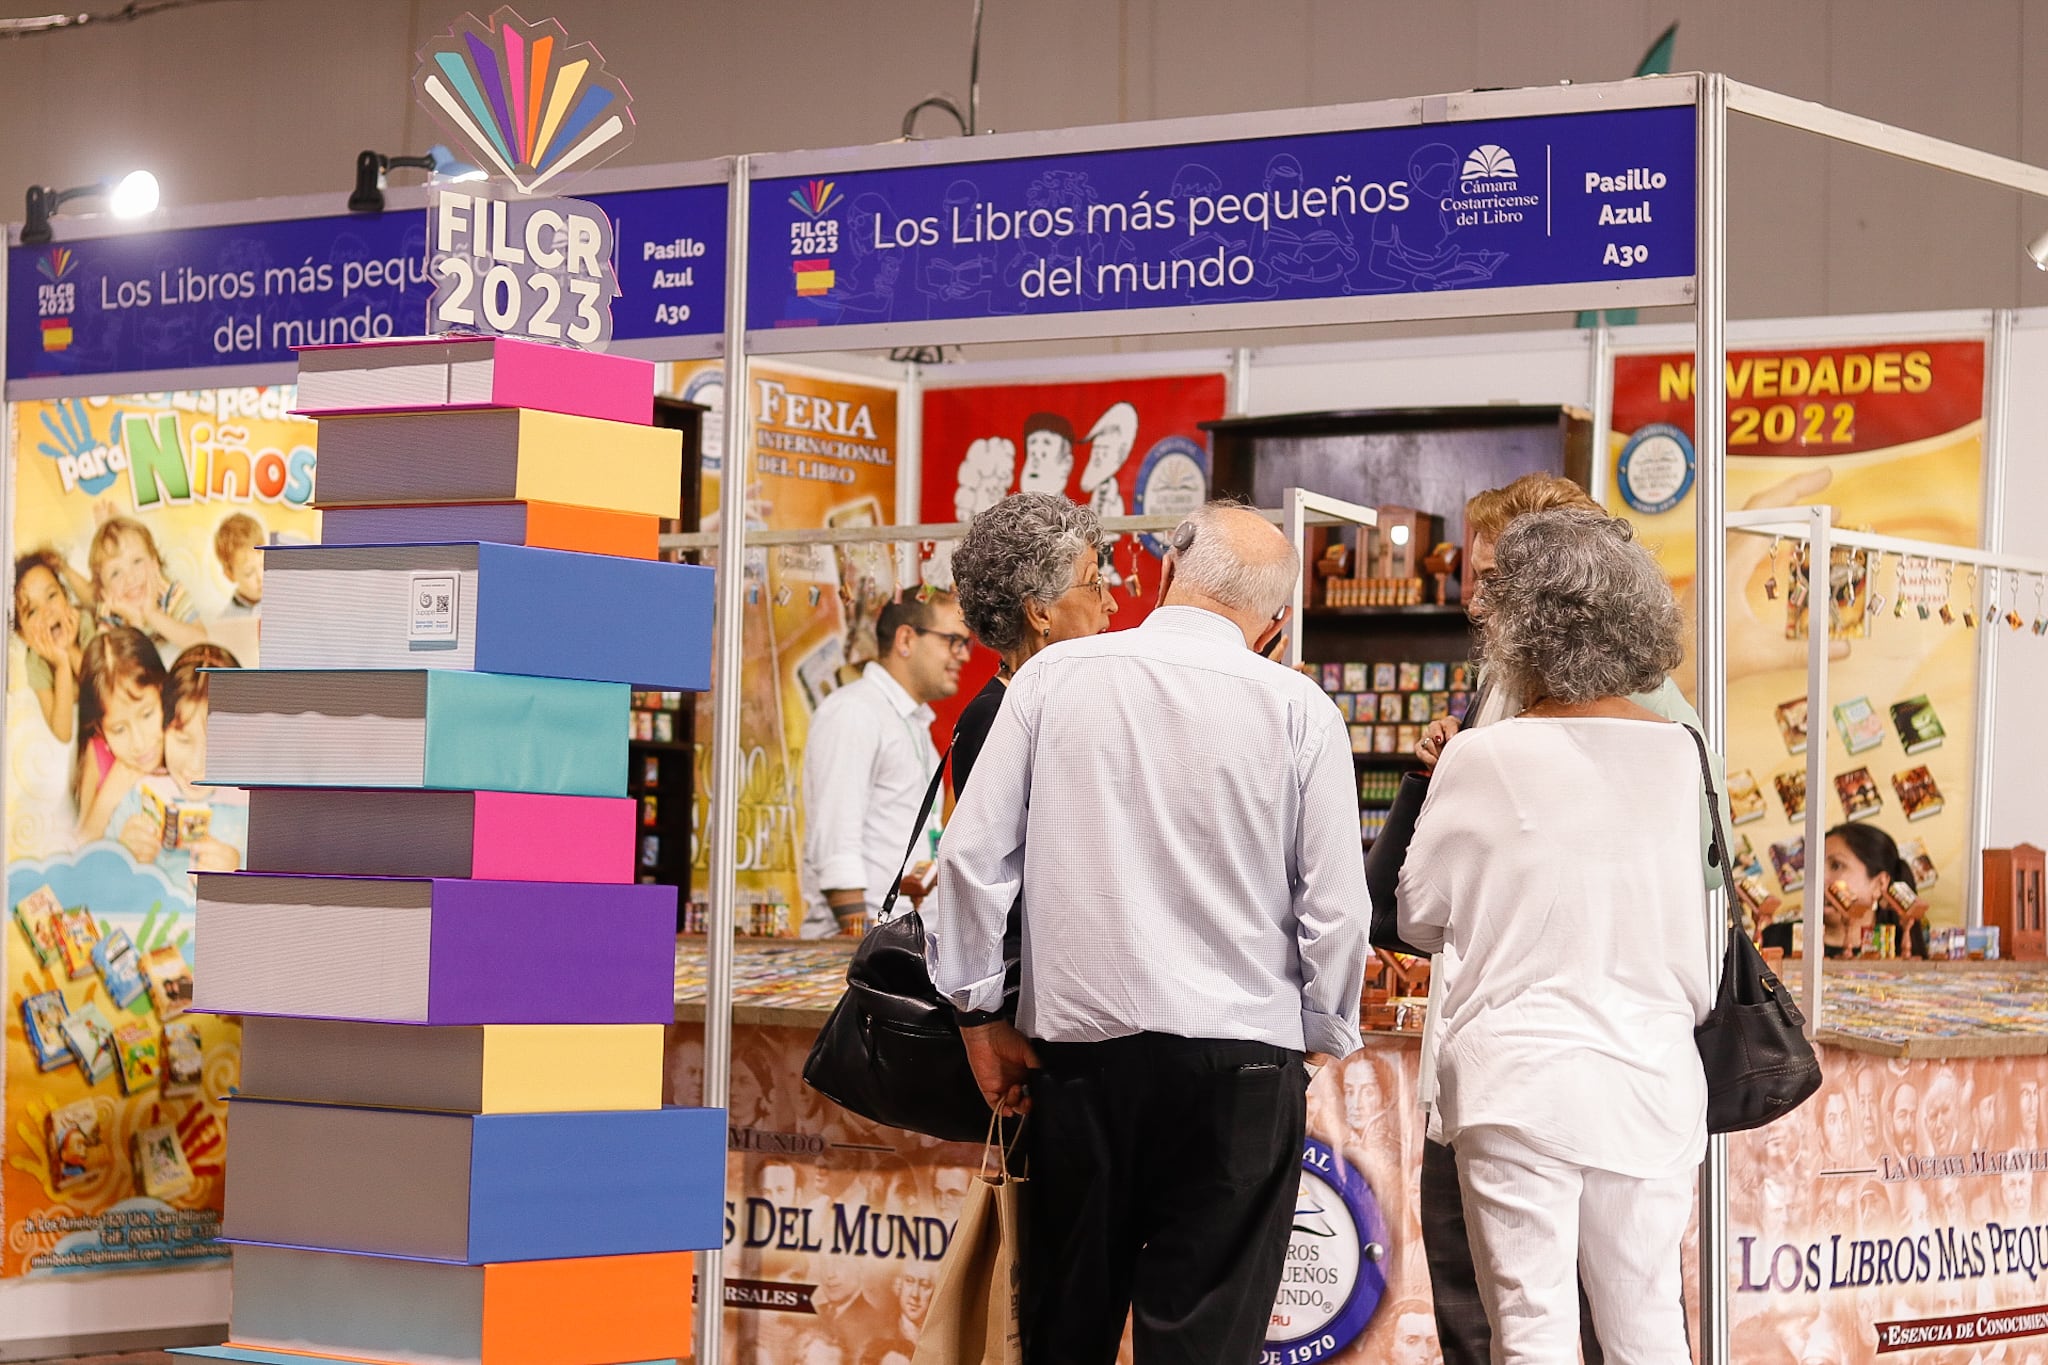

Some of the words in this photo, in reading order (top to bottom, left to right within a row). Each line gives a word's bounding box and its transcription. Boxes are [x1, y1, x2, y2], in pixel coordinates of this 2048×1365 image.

[1460, 177, 1517, 195] Cámara
[1585, 167, 1667, 195] Pasillo
[874, 212, 940, 251] Los
[952, 202, 1074, 246] Libros
[1087, 190, 1176, 233] más
[1189, 174, 1411, 237] pequeños
[1440, 192, 1539, 213] Costarricense
[1456, 210, 1480, 226] del
[1483, 208, 1524, 225] Libro
[1598, 201, 1652, 227] Azul
[438, 190, 603, 279] FILCR
[790, 219, 839, 239] FILCR
[643, 238, 706, 261] Pasillo
[790, 237, 839, 256] 2023
[1602, 243, 1649, 268] A30
[101, 274, 152, 310] Los
[160, 266, 256, 305] Libros
[264, 256, 334, 296] más
[652, 268, 694, 290] Azul
[1020, 255, 1082, 299] del
[1097, 246, 1255, 295] mundo
[438, 257, 602, 344] 2023
[655, 303, 690, 325] A30
[213, 314, 262, 353] del
[273, 306, 394, 350] mundo
[1659, 351, 1933, 403] NVEDADES
[756, 378, 878, 441] FERIA
[1727, 402, 1855, 447] 2022
[57, 442, 127, 495] para
[121, 410, 318, 512] Niños
[756, 428, 893, 467] INTERNACIONAL
[756, 453, 794, 478] DEL
[799, 458, 856, 485] LIBRO
[744, 1197, 822, 1252] DEL
[831, 1203, 959, 1262] MUND
[1287, 1244, 1320, 1261] ROS
[1737, 1236, 1821, 1294] LOS
[1829, 1233, 1931, 1290] LIBROS
[1934, 1226, 1985, 1282] MAS
[725, 1287, 798, 1307] RSALES
[1275, 1289, 1324, 1307] UNDO
[1888, 1320, 1952, 1347] ESENCIA
[1955, 1323, 1974, 1340] DE
[1288, 1334, 1336, 1364] 1970
